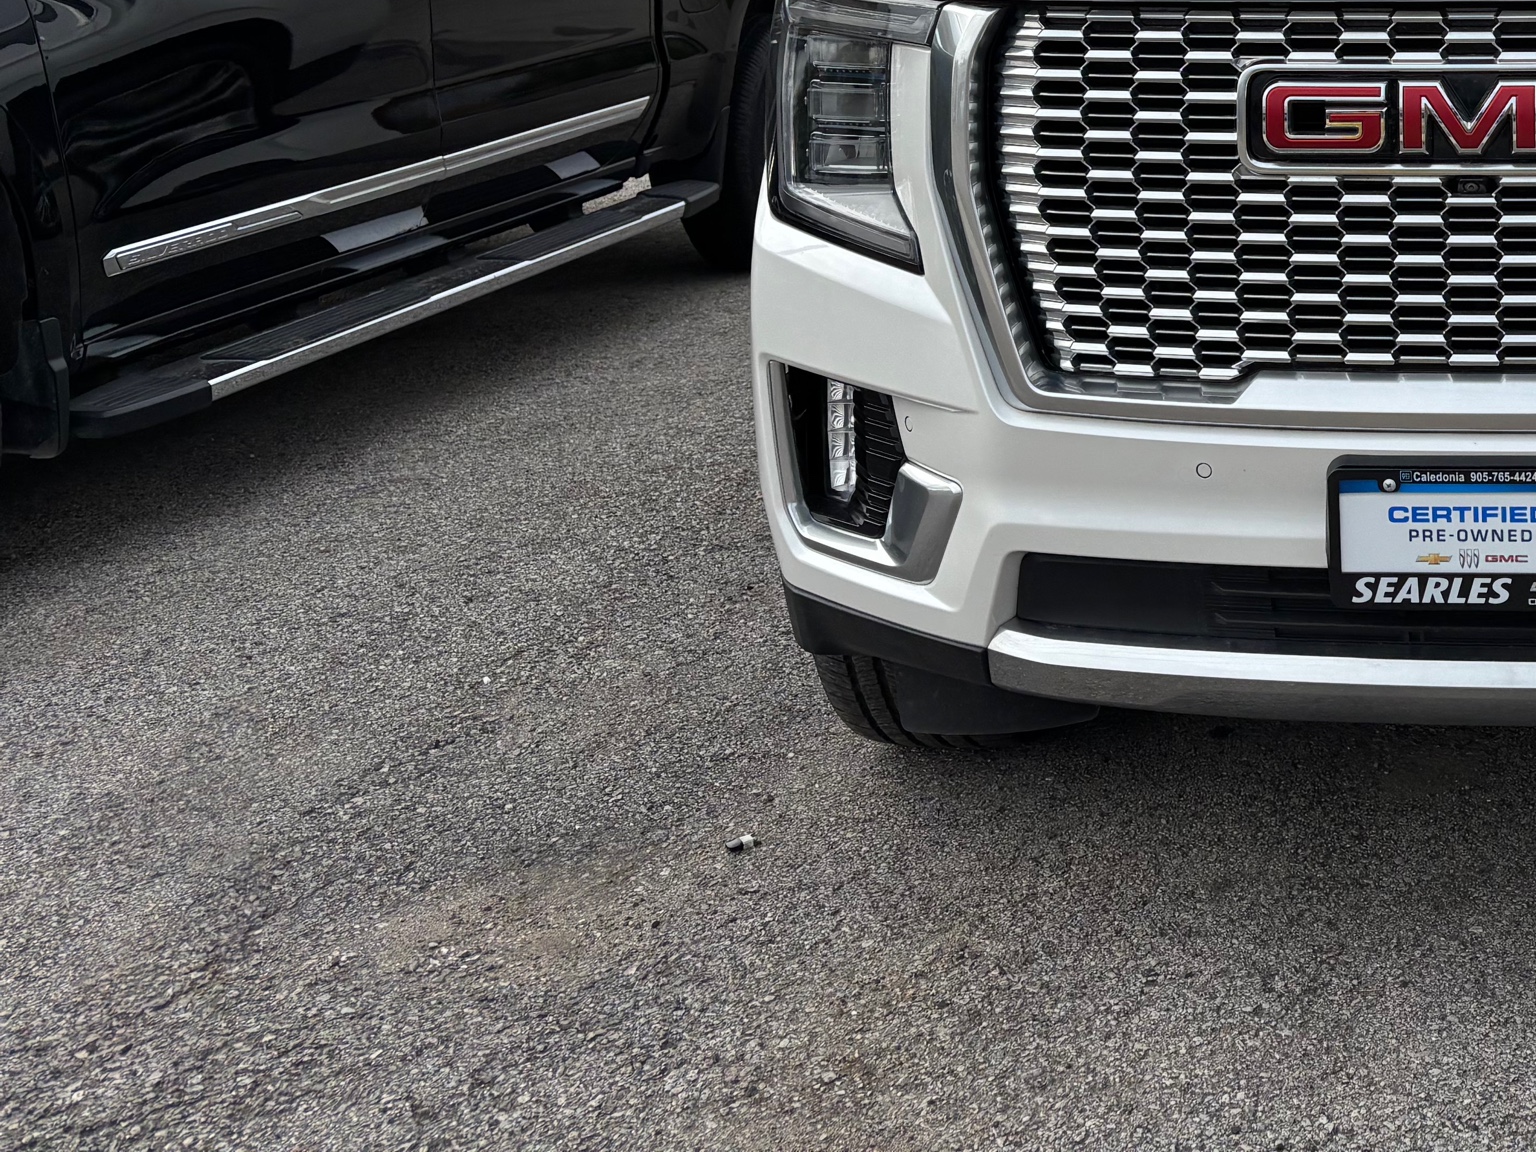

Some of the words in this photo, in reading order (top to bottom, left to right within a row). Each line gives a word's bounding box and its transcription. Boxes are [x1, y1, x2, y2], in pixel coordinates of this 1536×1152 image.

[1413, 471, 1465, 482] Caledonia
[1408, 529, 1534, 543] PRE-OWNED
[1484, 554, 1529, 564] GMC
[1351, 576, 1513, 605] SEARLES
